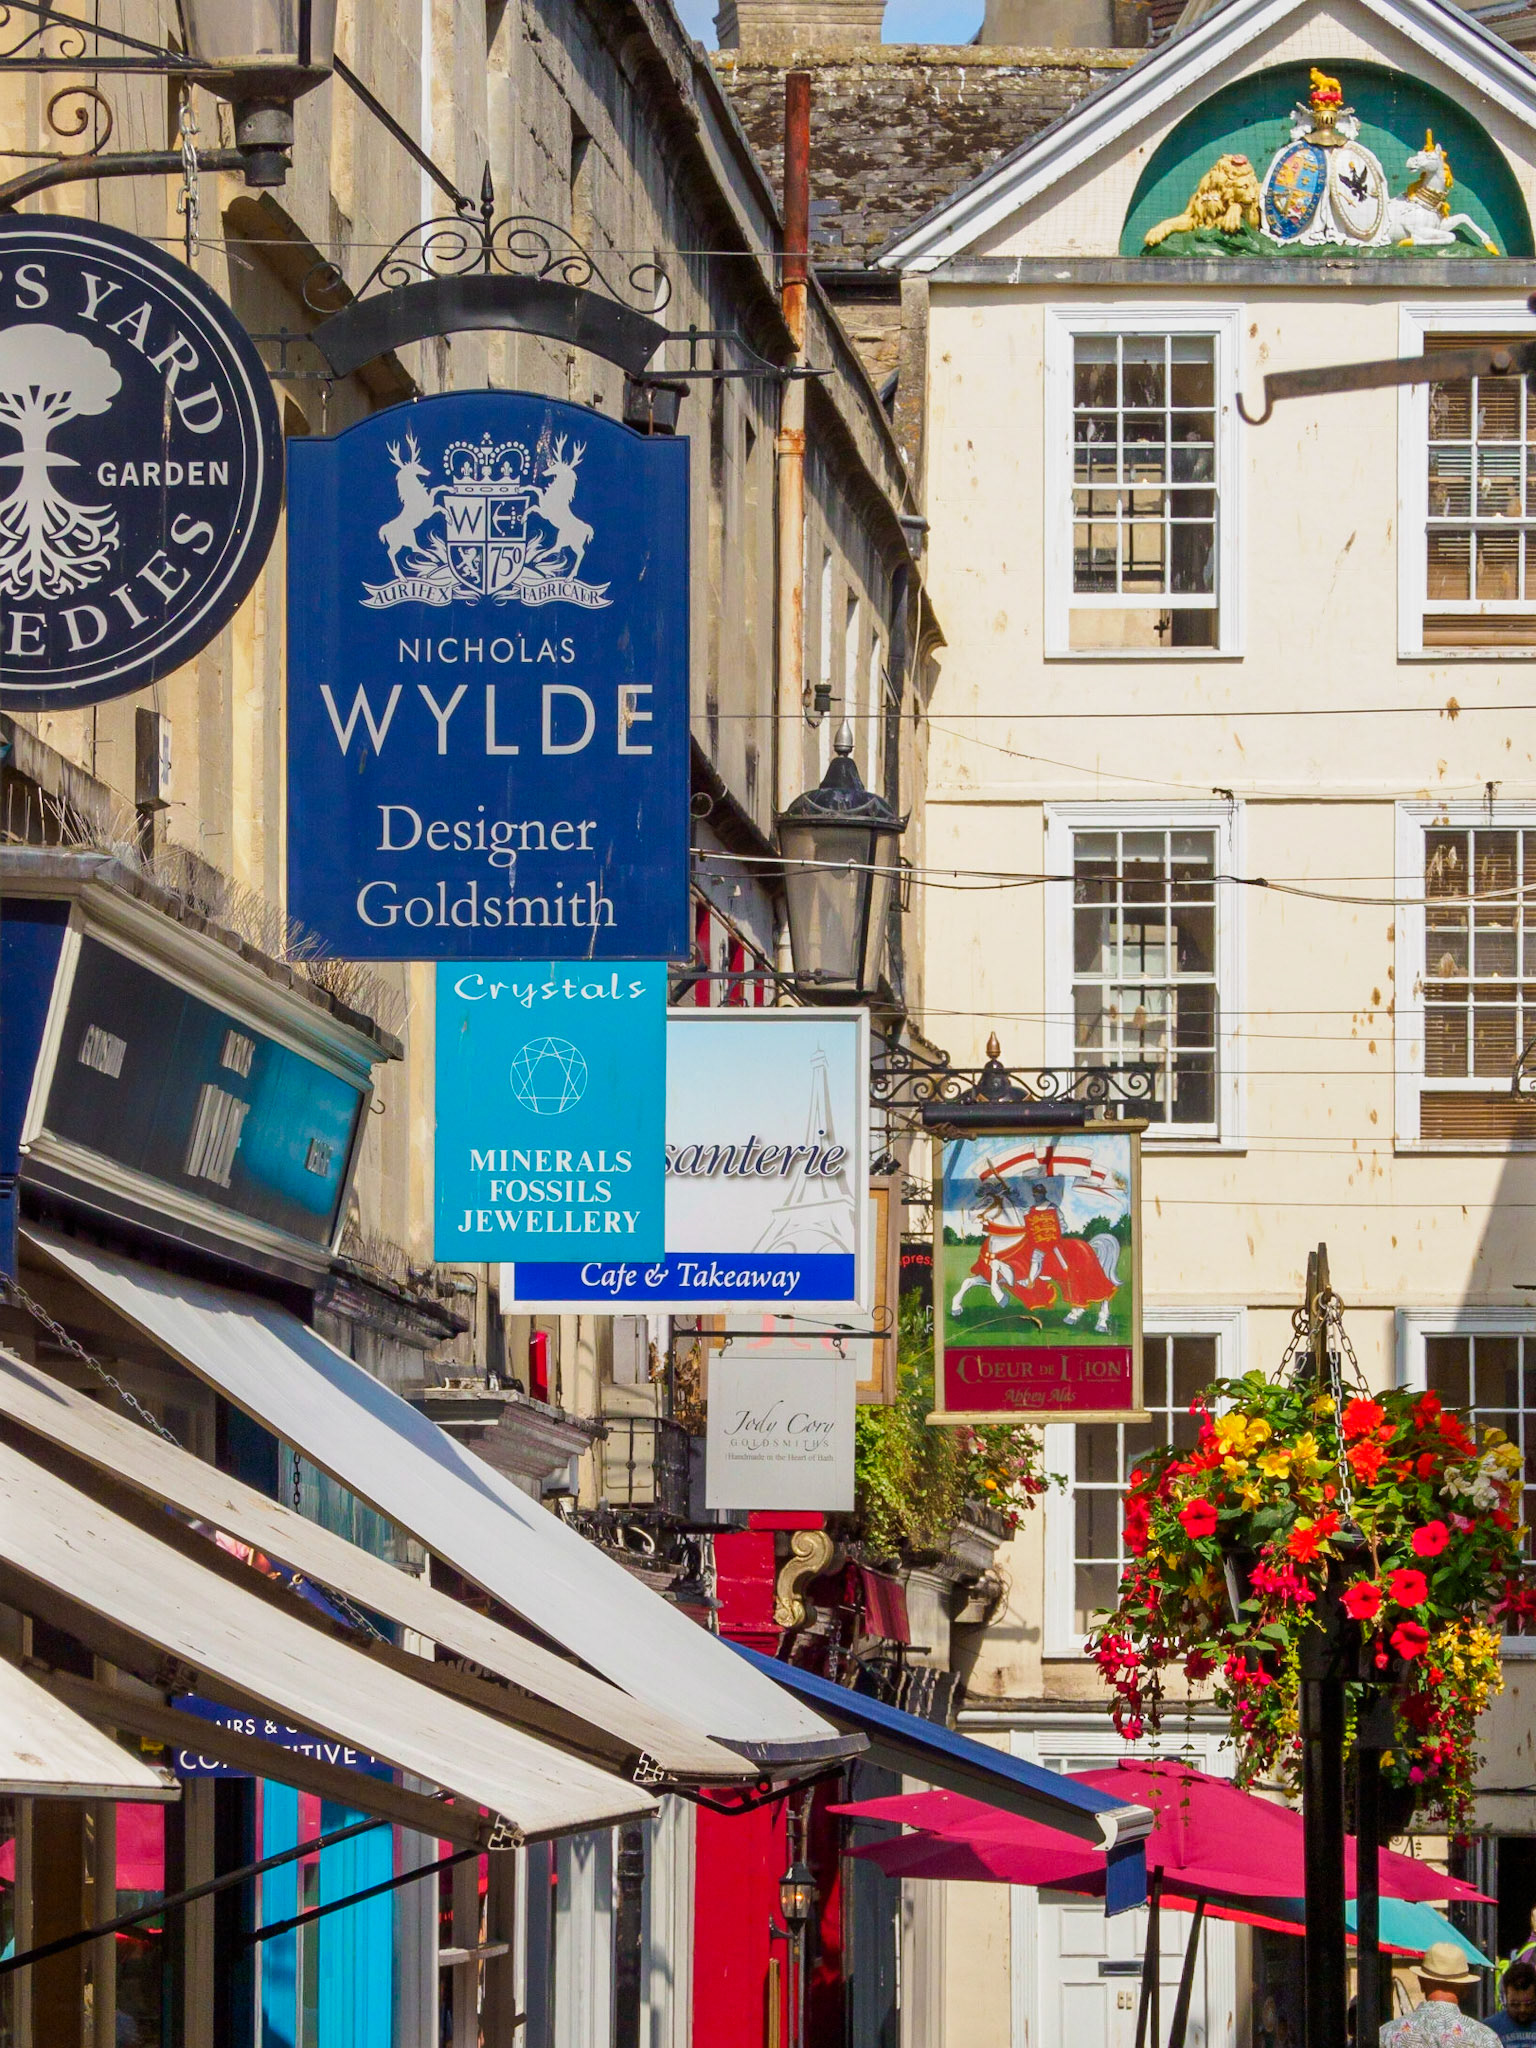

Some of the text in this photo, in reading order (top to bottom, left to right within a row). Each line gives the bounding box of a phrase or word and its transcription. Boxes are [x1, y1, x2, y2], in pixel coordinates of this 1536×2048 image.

[78, 270, 225, 435] YARD
[97, 461, 229, 487] GARDEN
[450, 505, 483, 536] W
[373, 584, 450, 604] AURIFEX
[523, 584, 600, 604] FABRICATOR
[399, 637, 576, 664] NICHOLAS
[320, 683, 654, 758] WYLDE
[377, 804, 598, 868] Designer
[356, 880, 618, 930] Goldsmith
[453, 972, 647, 1009] Crystals
[469, 1149, 633, 1173] MINERALS
[489, 1179, 612, 1203] FOSSILS
[457, 1209, 642, 1234] JEWELLERY
[580, 1261, 801, 1297] Cafe & Takeaway
[723, 1400, 835, 1452] Jody Cory
[730, 1439, 830, 1448] GOLDSMITHS
[216, 1719, 256, 1735] IRS
[264, 1719, 278, 1734] &
